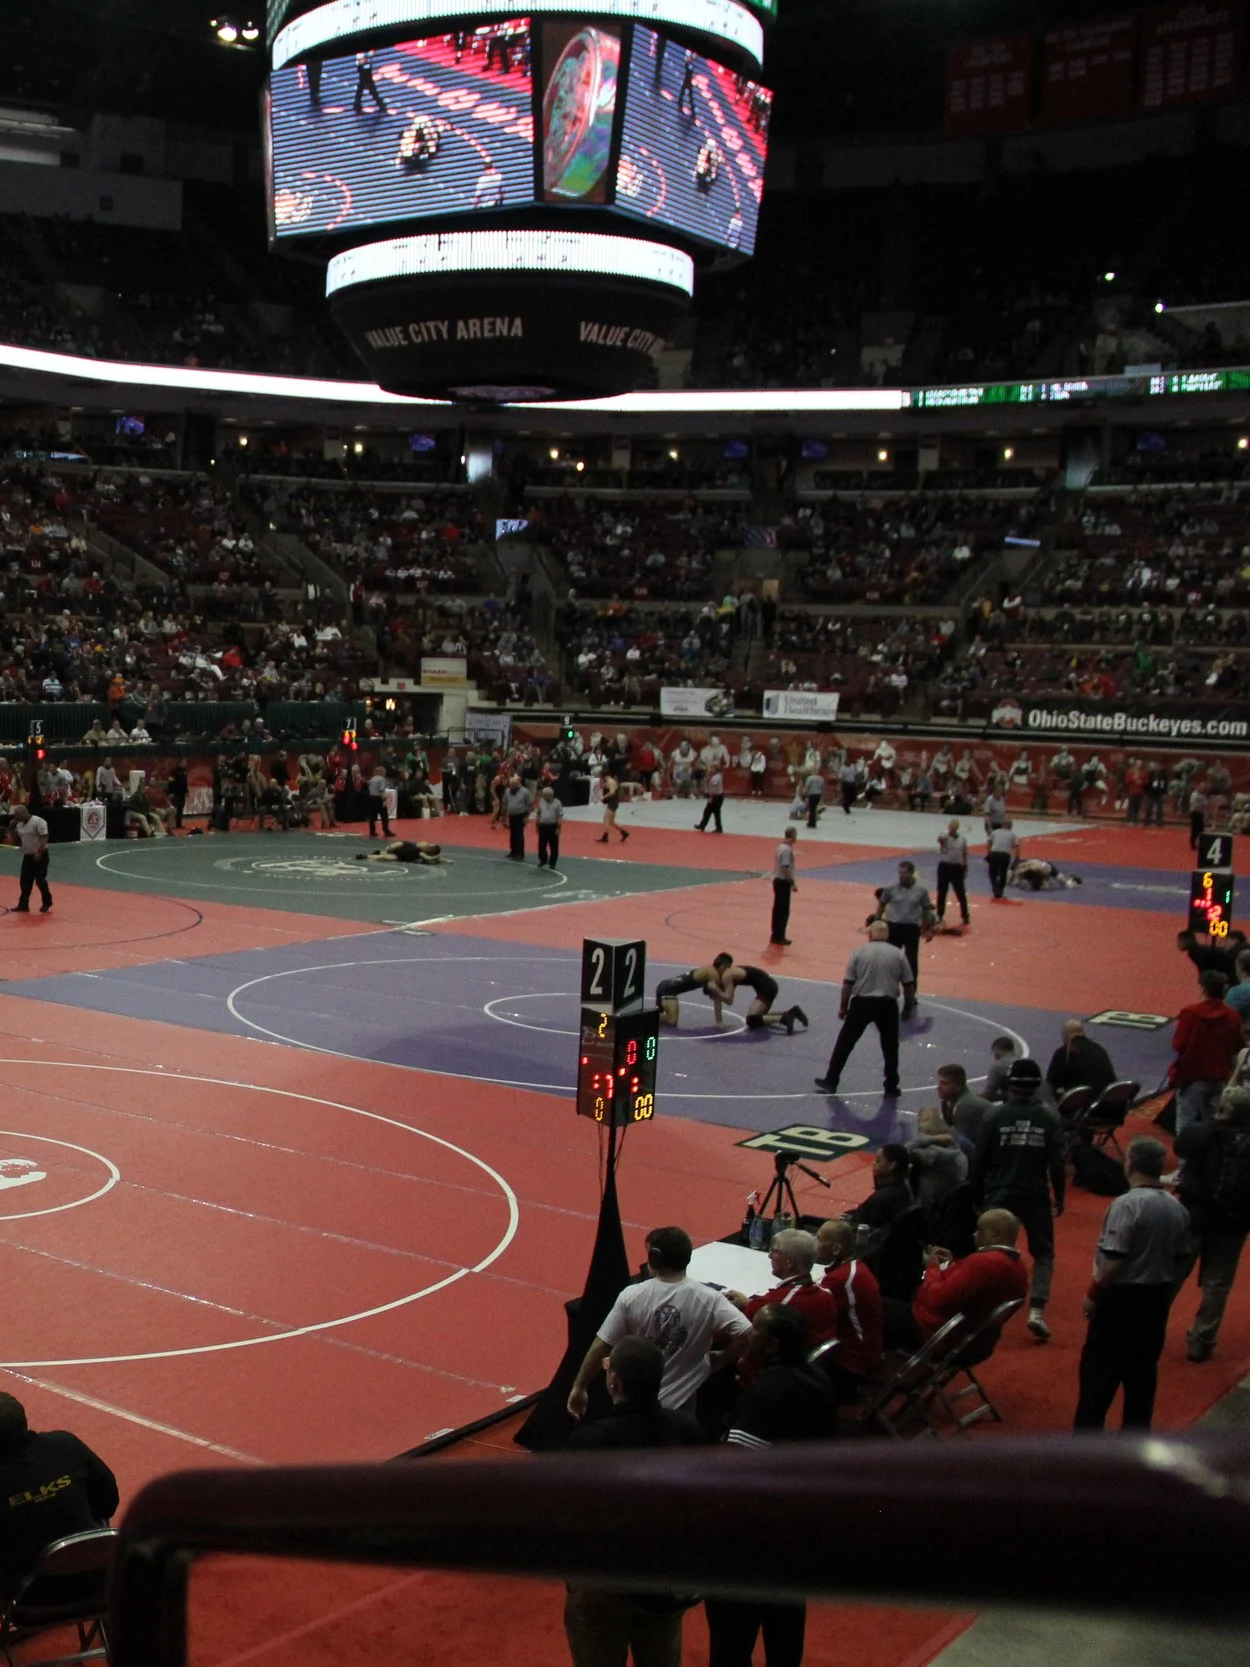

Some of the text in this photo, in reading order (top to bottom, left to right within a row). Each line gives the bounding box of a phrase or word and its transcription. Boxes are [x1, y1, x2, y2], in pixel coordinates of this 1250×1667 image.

[364, 316, 523, 349] VALUE CITY ARENA
[579, 320, 629, 347] VALUE
[1028, 709, 1248, 736] OhioStateBuckeyes.com
[1206, 838, 1222, 864] 4
[589, 947, 606, 995] 2
[623, 947, 638, 999] 2
[741, 1126, 870, 1156] TB
[8, 1474, 72, 1508] ELKS
